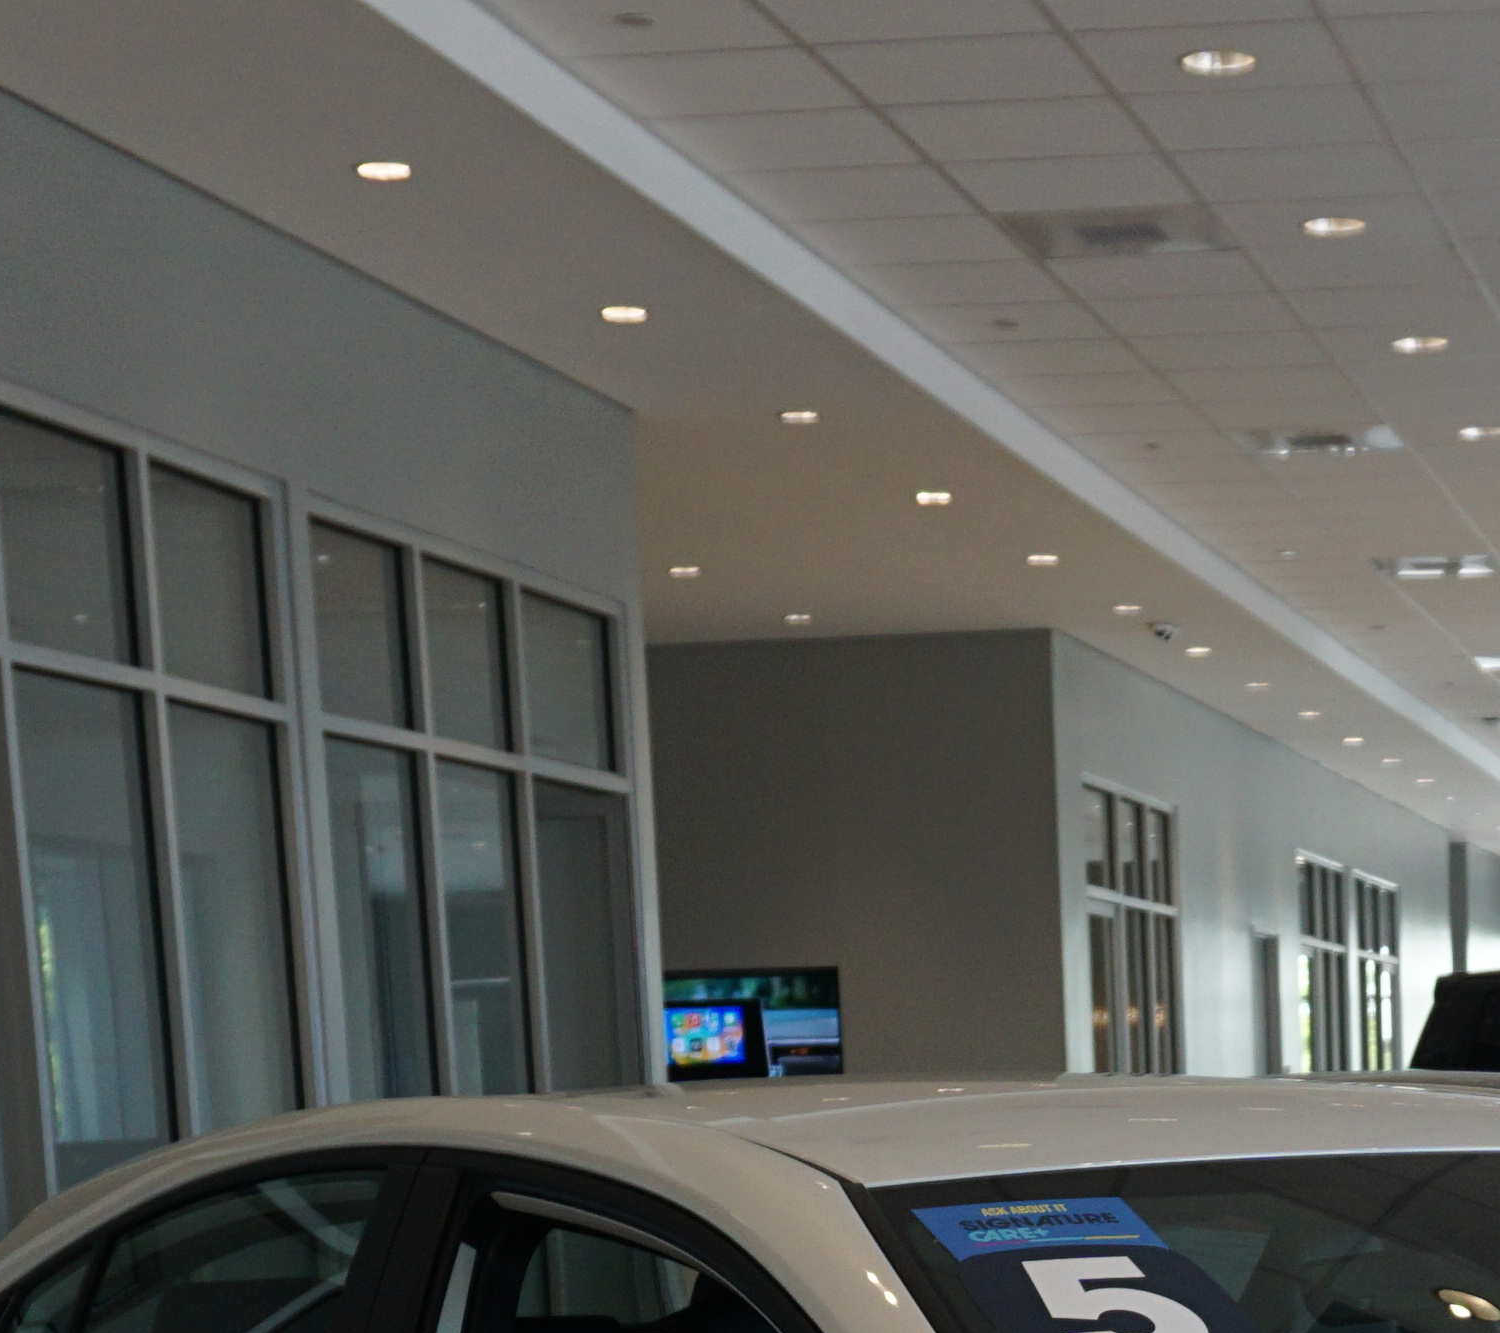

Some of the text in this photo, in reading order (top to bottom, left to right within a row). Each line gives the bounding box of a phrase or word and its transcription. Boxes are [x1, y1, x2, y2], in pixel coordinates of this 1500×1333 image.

[980, 1203, 1068, 1217] ASK ABOUT IT
[959, 1211, 1120, 1231] SIGNATURE
[968, 1227, 1049, 1243] CARE+
